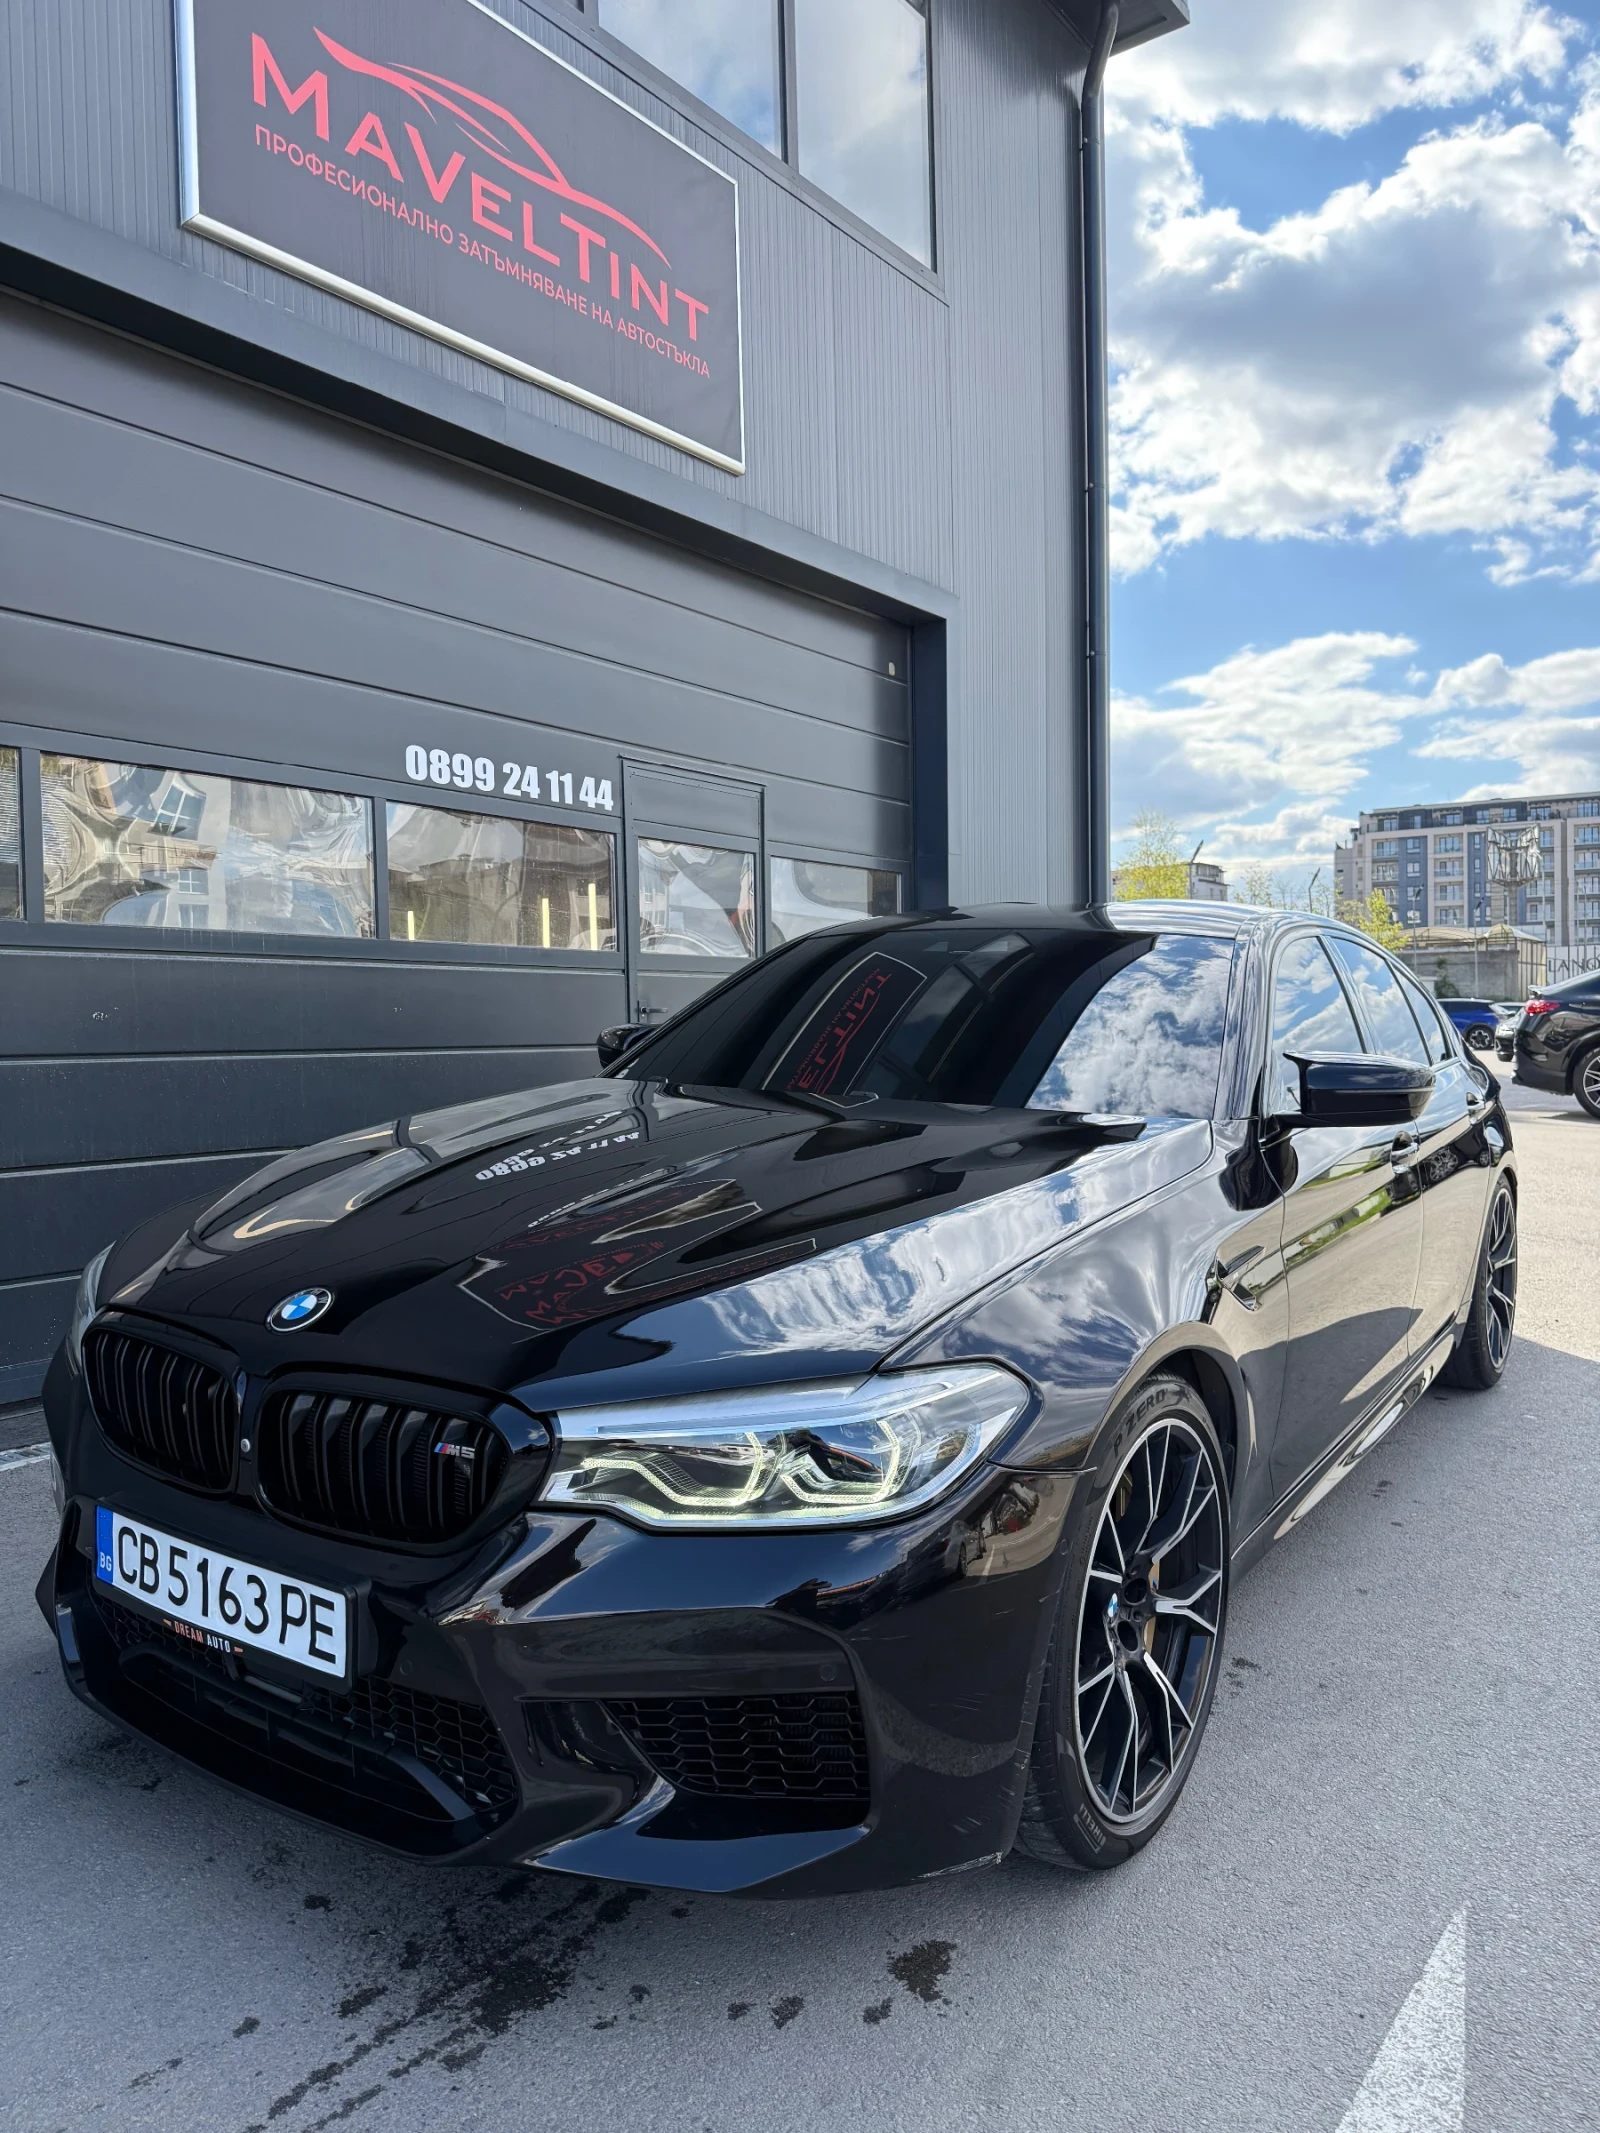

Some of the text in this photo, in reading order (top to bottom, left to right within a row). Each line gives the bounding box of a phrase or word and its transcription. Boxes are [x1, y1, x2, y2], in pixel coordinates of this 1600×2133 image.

[251, 32, 709, 341] MAVELTINT
[255, 123, 710, 378] ПРОФЕСИОНАЛНО ЗАТЪМНЯВАНЕ НА АВТОСТЪКЛА
[405, 744, 614, 811] 0899 24 11 44
[446, 1444, 476, 1460] M5
[100, 1551, 112, 1572] BG
[174, 1620, 231, 1653] DREAM AUTO
